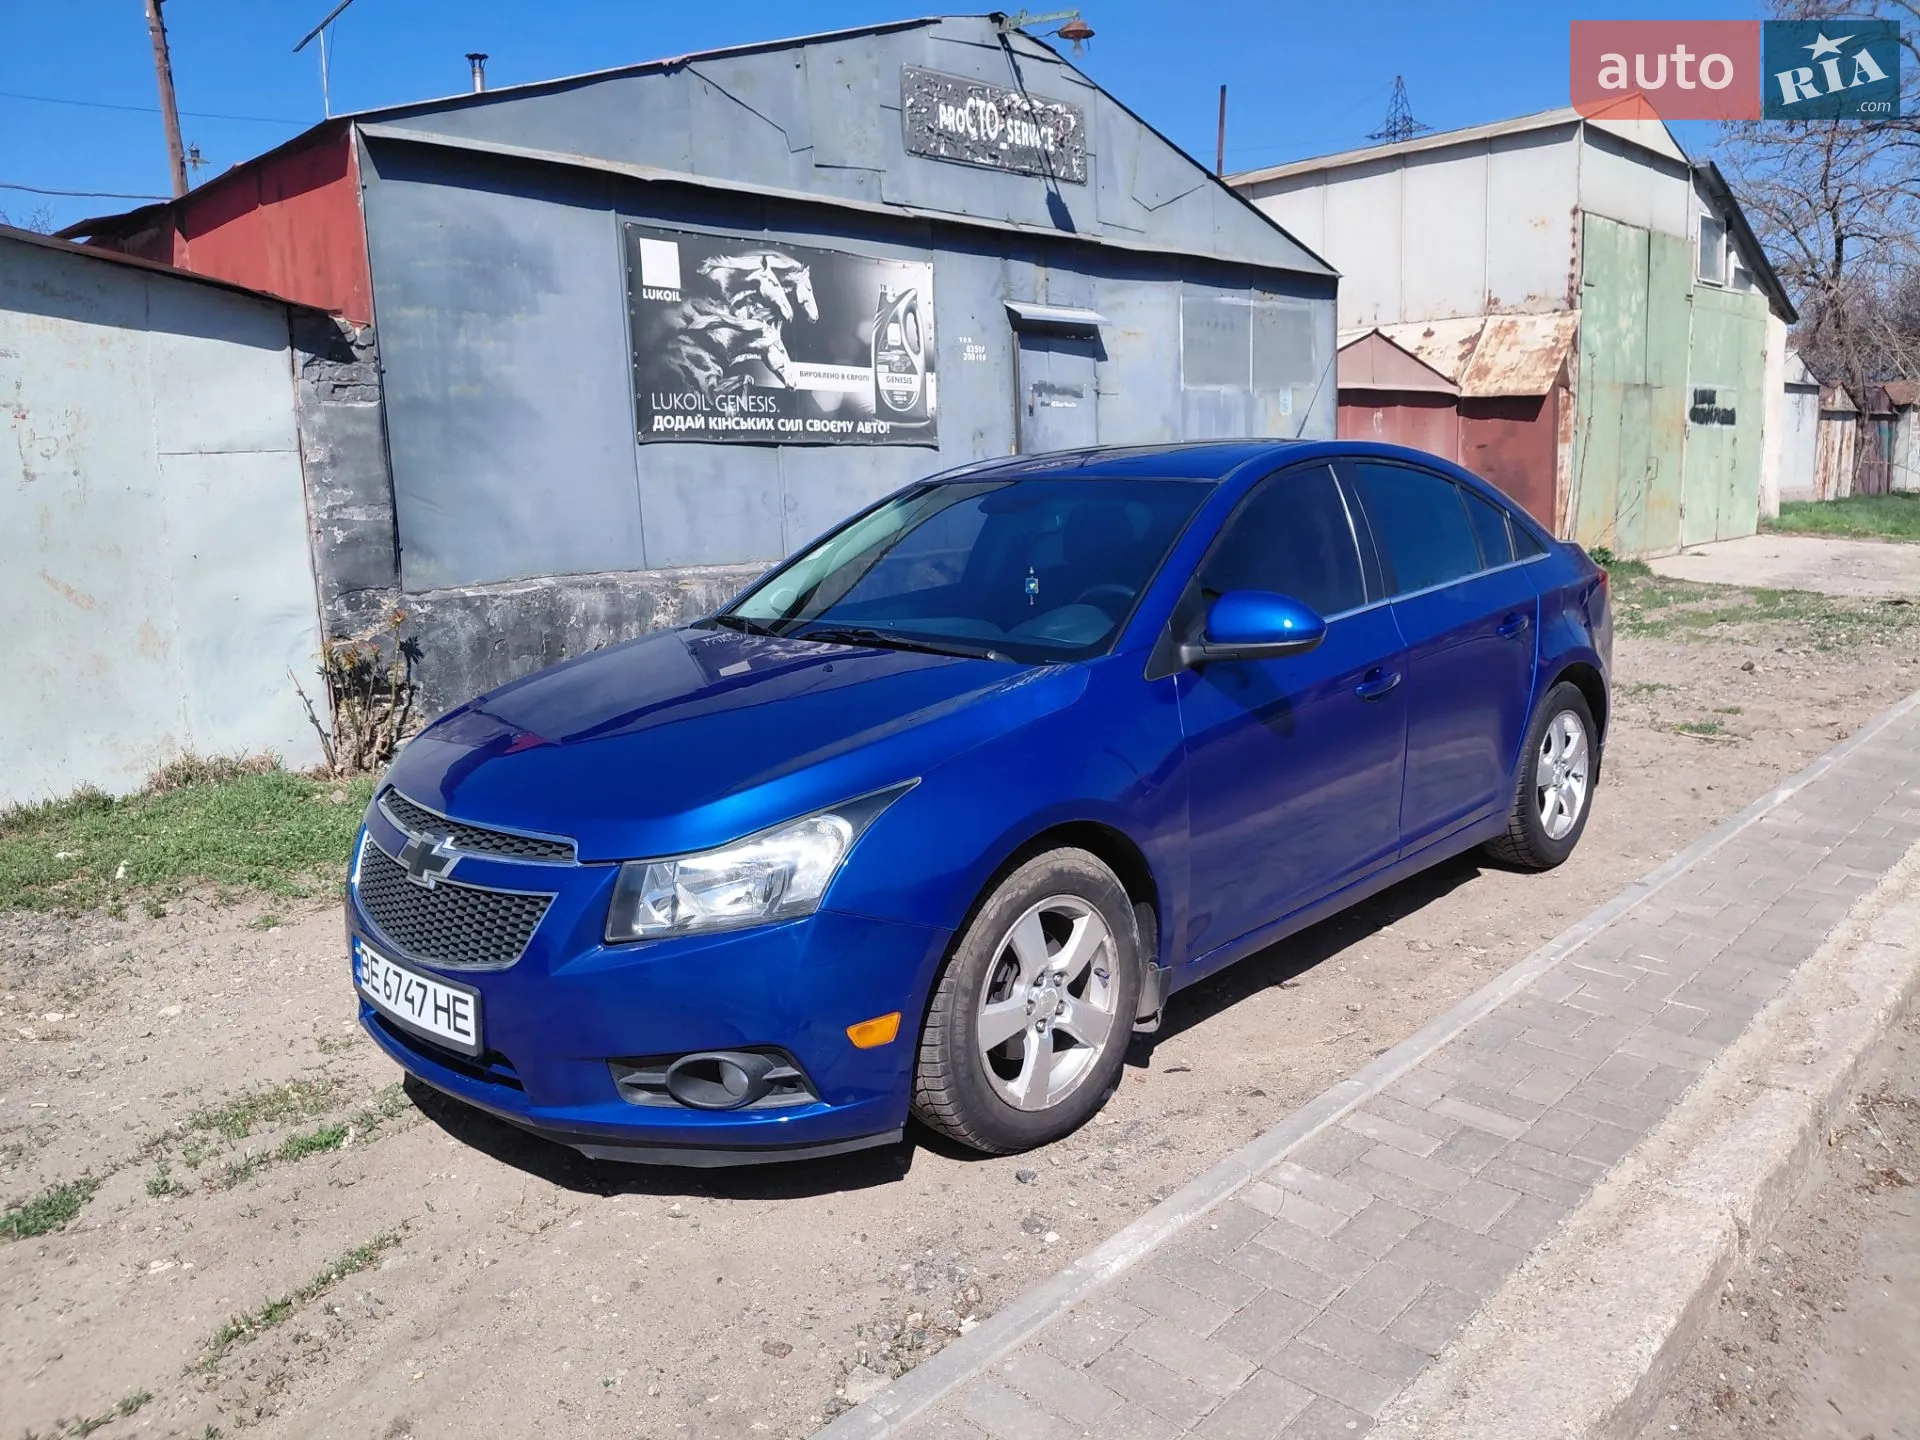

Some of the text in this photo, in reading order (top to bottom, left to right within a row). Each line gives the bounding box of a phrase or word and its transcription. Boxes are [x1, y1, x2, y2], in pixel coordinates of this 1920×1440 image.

[642, 287, 682, 302] LUKOIL
[799, 369, 840, 381] ВИРОБЛЕНО
[885, 375, 913, 385] GENESIS
[651, 391, 781, 414] LUKOIL GENESIS.
[652, 413, 891, 434] ДОДАЙ КІНСЬКИХ СИЛ СВОЄМУ АВТО!
